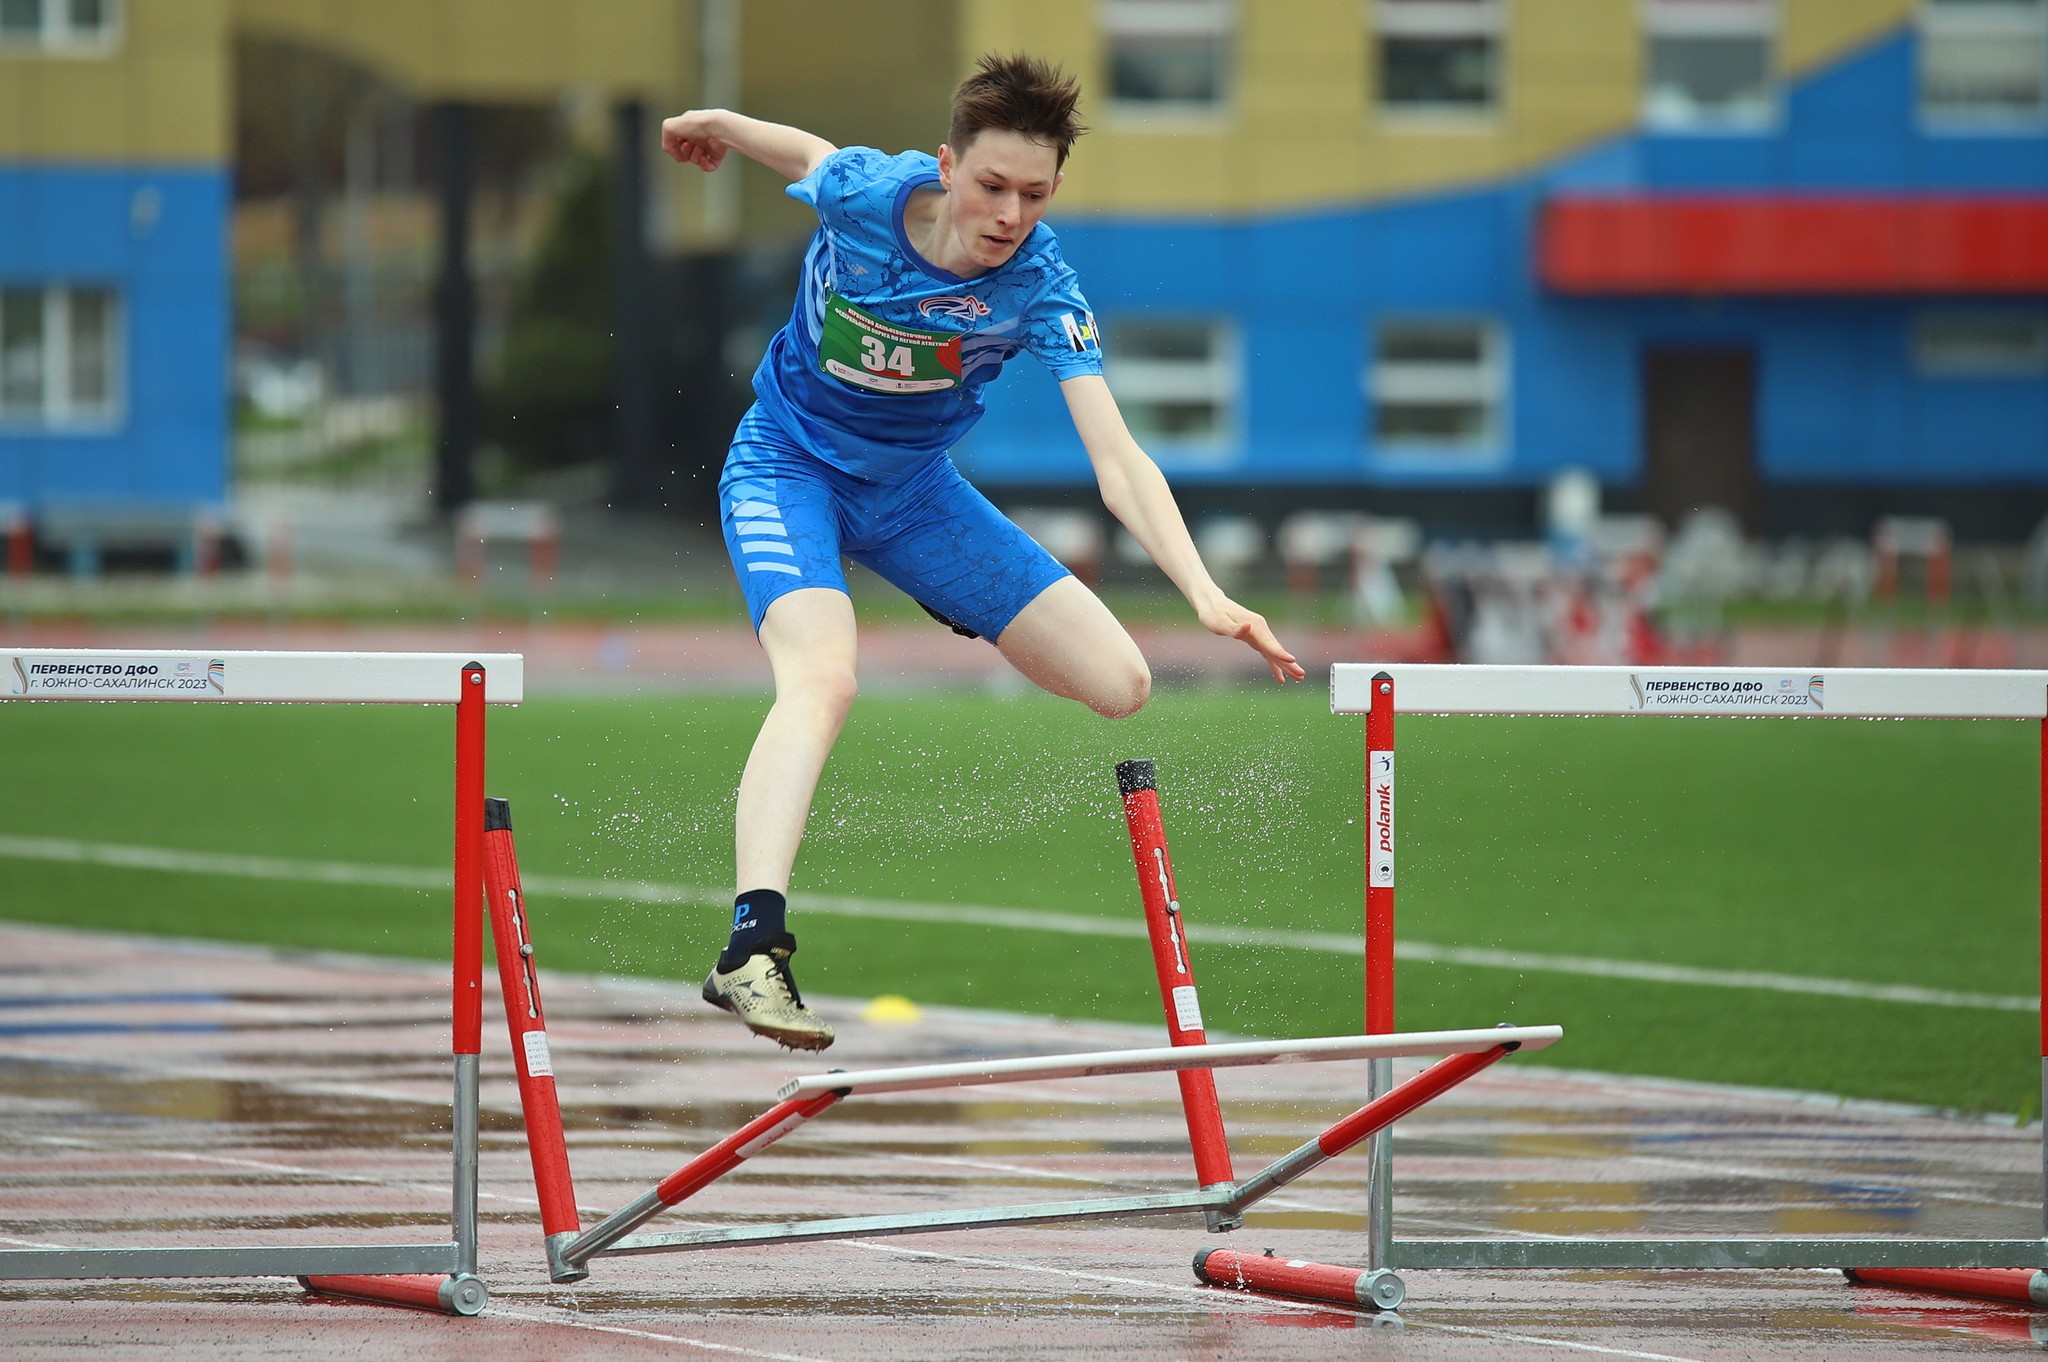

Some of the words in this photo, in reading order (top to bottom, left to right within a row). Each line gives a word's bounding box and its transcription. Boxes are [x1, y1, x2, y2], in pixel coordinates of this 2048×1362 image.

[860, 335, 916, 377] 34
[30, 664, 122, 675] ПЕРВЕНСТВО
[125, 664, 159, 676] ДФО
[30, 679, 38, 688] г.
[41, 677, 175, 689] ЮЖНО-САХАЛИНСК
[177, 679, 207, 689] 2023
[1645, 681, 1730, 692] ПЕРВЕНСТВО
[1731, 682, 1763, 693] ДФО
[1645, 696, 1653, 705] г.
[1656, 694, 1779, 706] ЮЖНО-САХАЛИНСК
[1780, 695, 1808, 706] 2023
[1376, 783, 1393, 853] polanik
